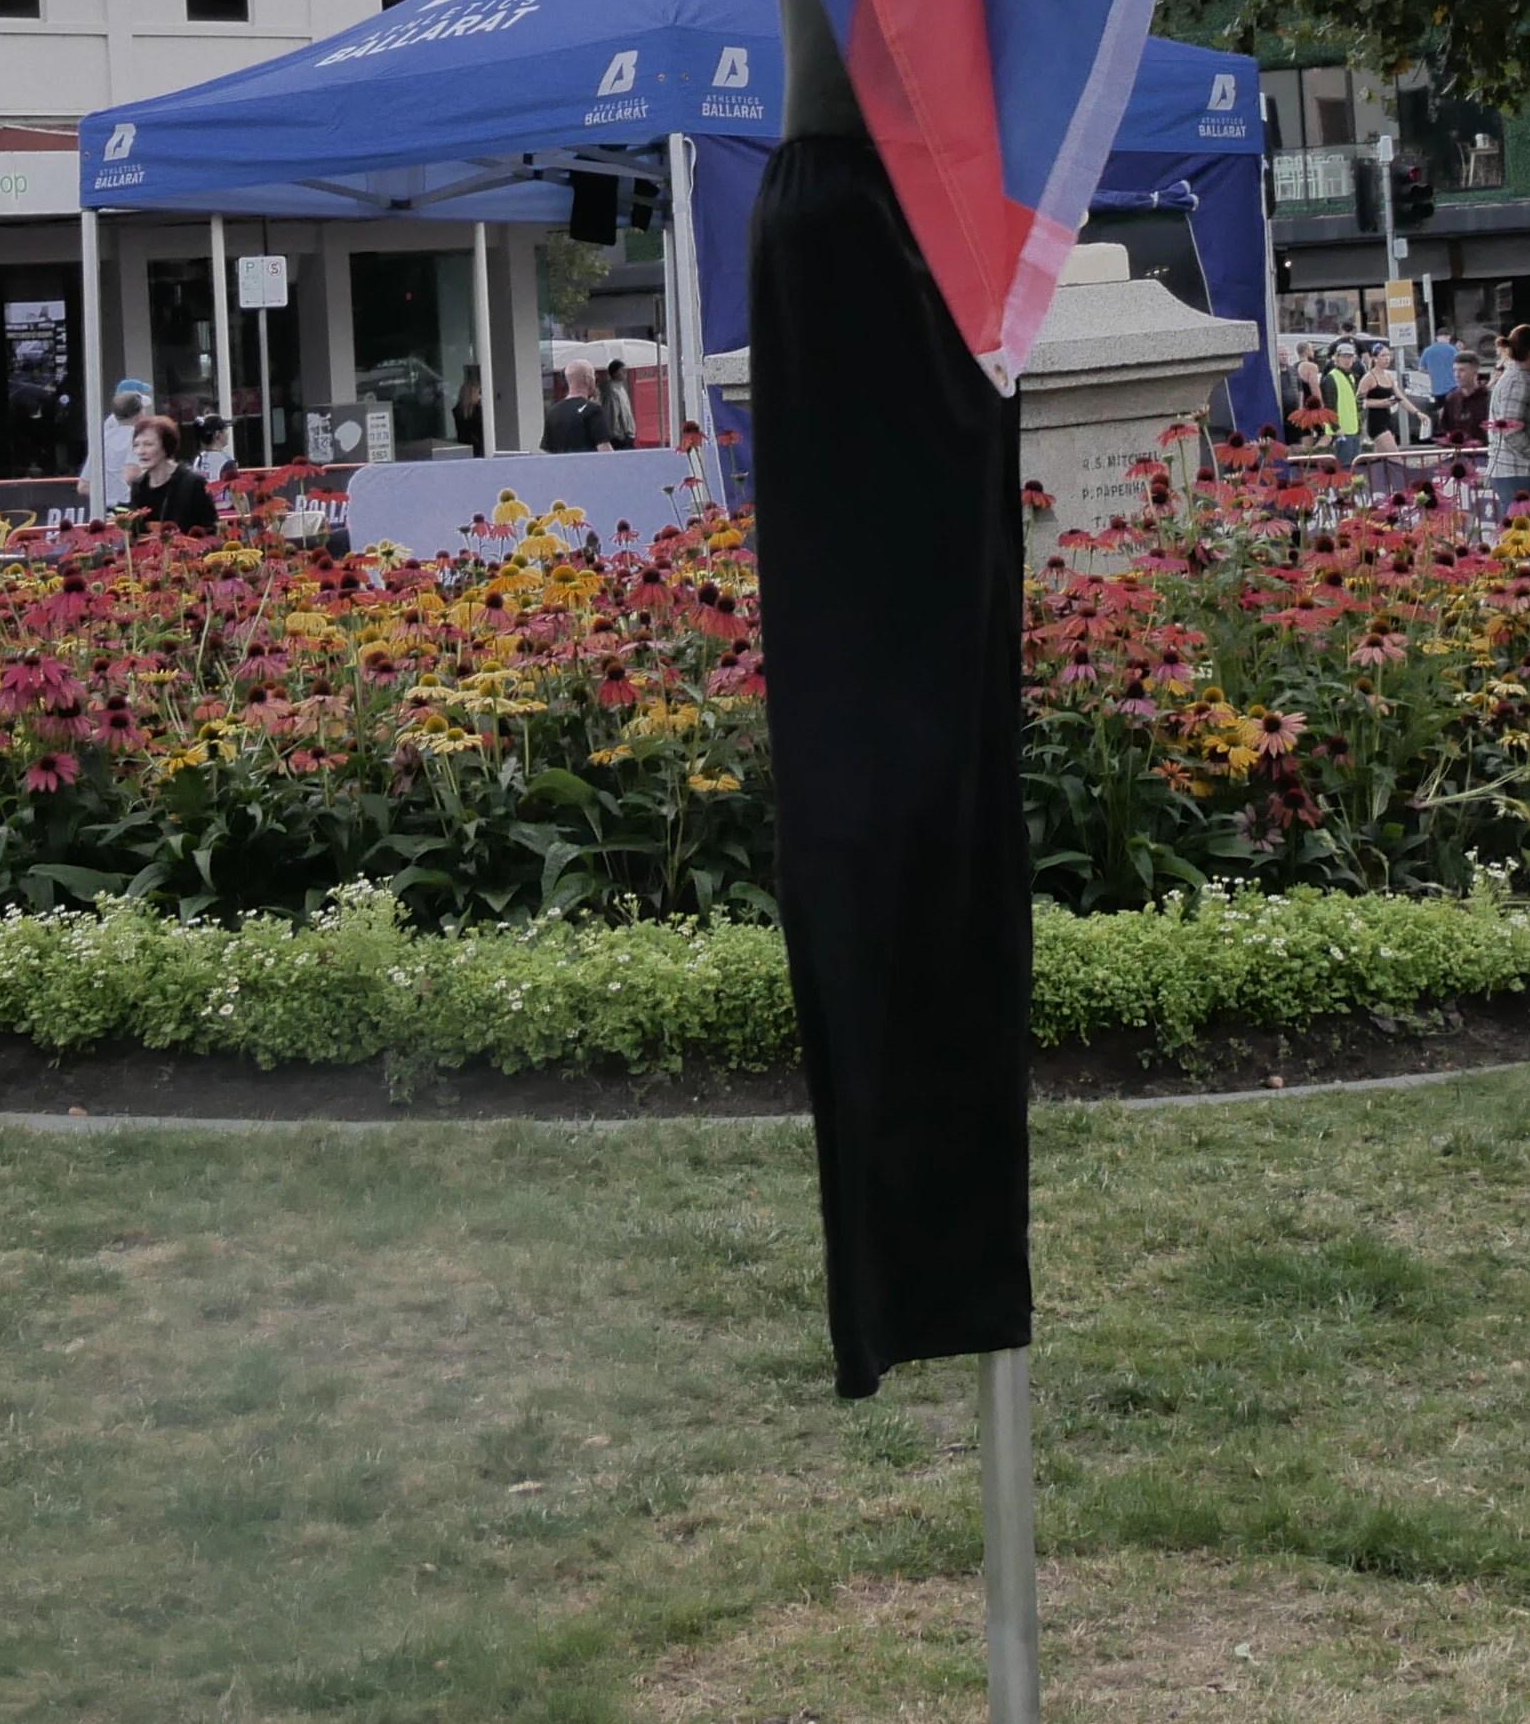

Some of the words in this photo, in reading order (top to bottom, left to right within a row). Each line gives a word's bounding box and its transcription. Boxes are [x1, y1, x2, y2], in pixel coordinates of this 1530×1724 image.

[314, 6, 540, 67] BALLARAT
[593, 97, 644, 113] ATHLETICS
[705, 95, 760, 105] ATHLETICS
[584, 105, 648, 126] BALLARAT
[701, 103, 764, 120] BALLARAT
[1199, 125, 1246, 138] BALLARAT
[94, 171, 145, 189] BALLARAT
